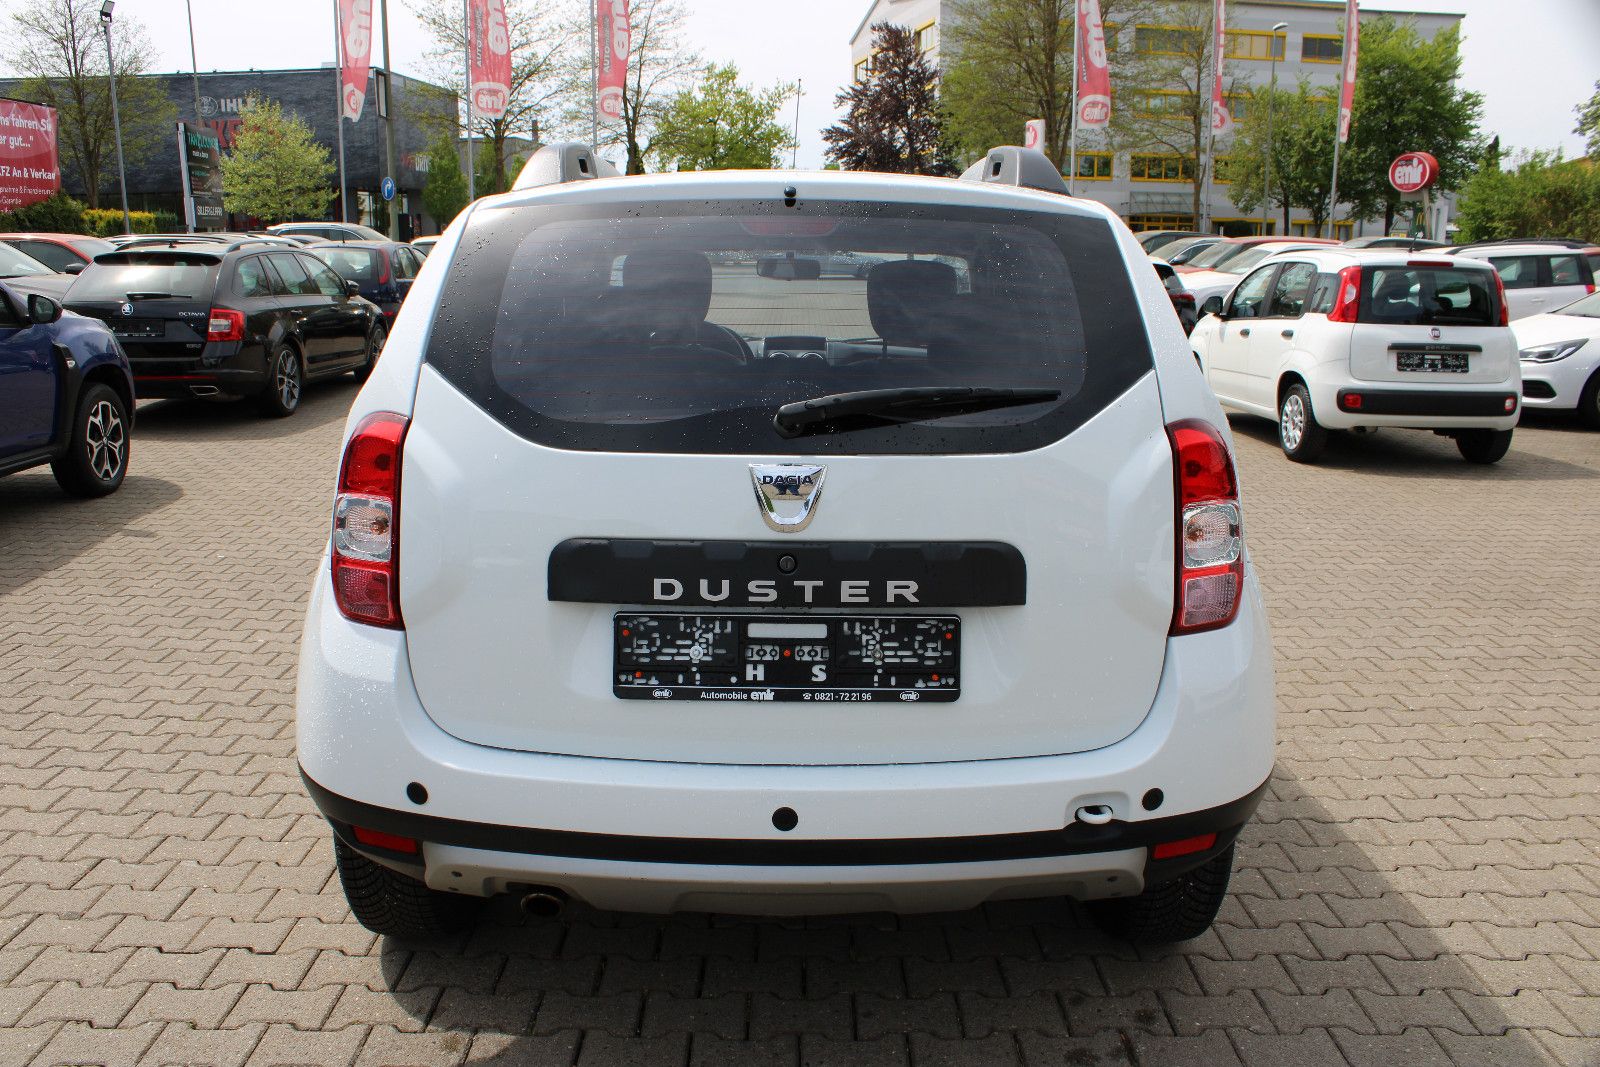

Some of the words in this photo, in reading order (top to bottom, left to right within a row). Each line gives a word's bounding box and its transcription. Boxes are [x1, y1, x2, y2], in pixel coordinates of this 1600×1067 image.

[11, 114, 38, 129] fahren
[12, 167, 22, 178] An
[1395, 158, 1423, 185] emir
[762, 475, 814, 485] DACIA
[653, 578, 920, 603] DUSTER
[700, 691, 748, 700] Automobile
[750, 689, 775, 700] emir
